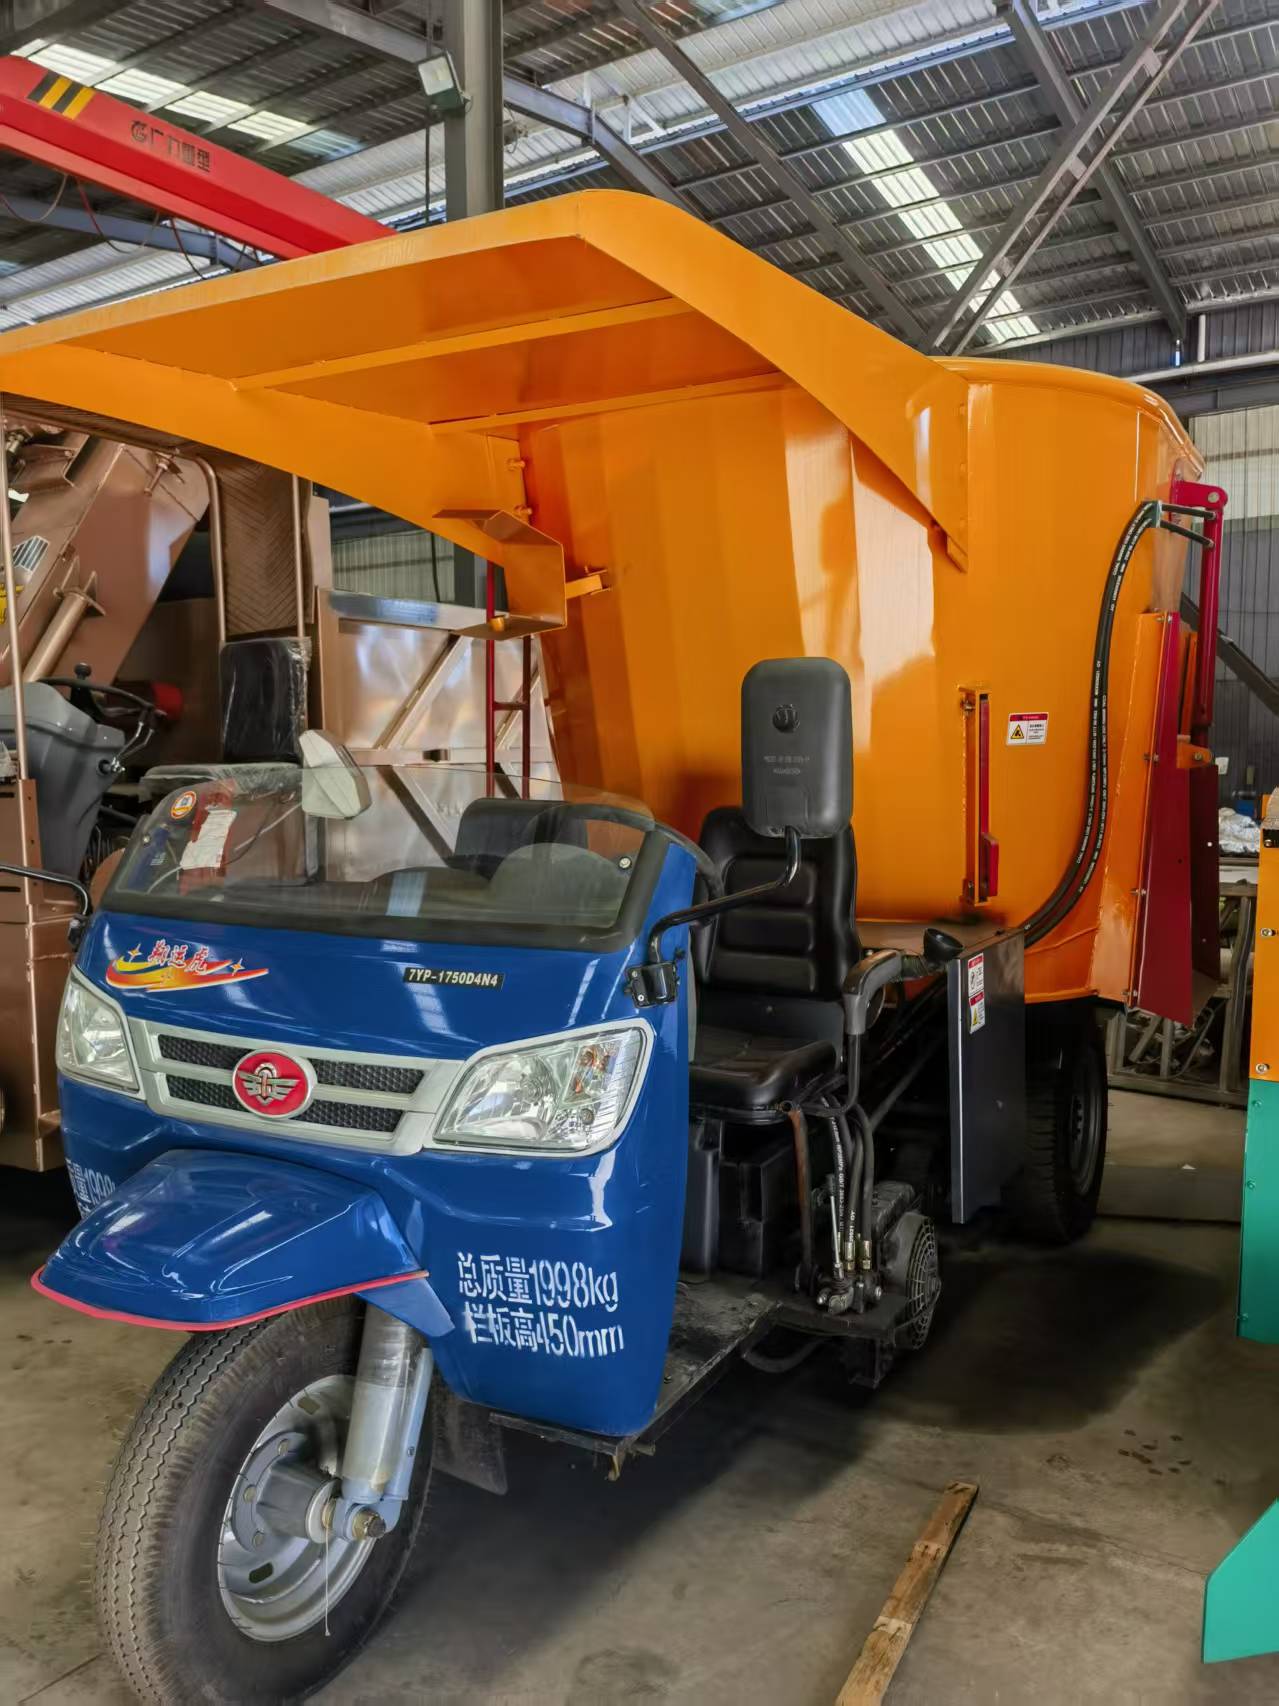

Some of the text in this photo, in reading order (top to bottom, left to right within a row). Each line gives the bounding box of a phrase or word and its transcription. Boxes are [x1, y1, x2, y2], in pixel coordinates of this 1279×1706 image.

[408, 968, 499, 987] 7YP-1750D4N4
[457, 1252, 619, 1312] 总质量1998kg
